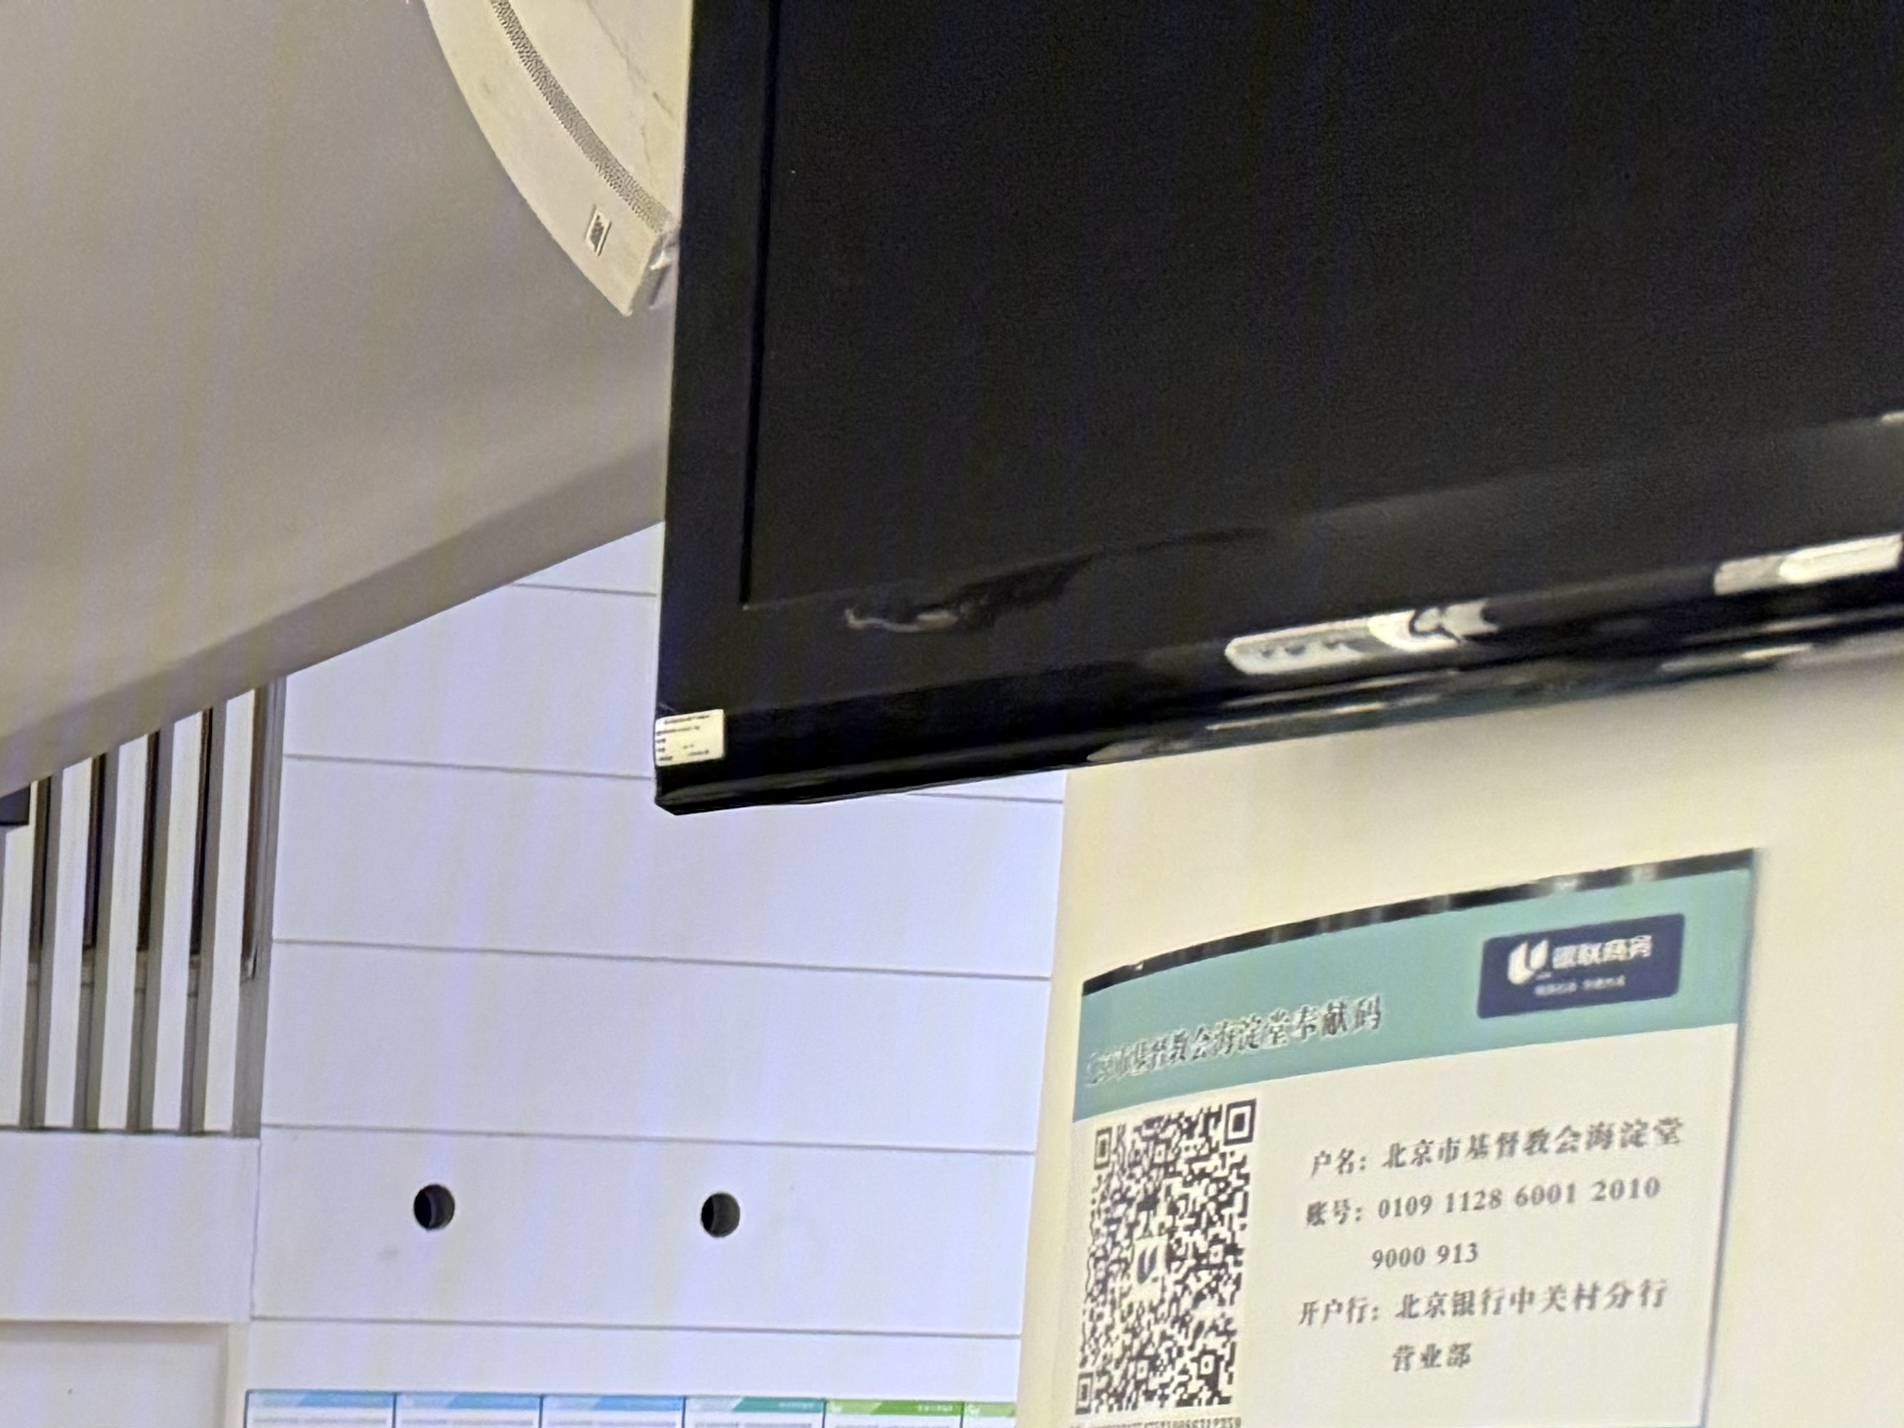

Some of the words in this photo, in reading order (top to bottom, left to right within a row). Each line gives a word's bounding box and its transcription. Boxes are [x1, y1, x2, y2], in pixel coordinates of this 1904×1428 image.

[1377, 1194, 1433, 1220] 0109
[1446, 1187, 1503, 1214] 1128
[1514, 1182, 1577, 1208] 6001
[1591, 1176, 1661, 1202] 2010
[1371, 1246, 1426, 1270] 9000
[1436, 1242, 1479, 1265] 913
[1394, 1278, 1668, 1320] 北京银行中关村分行
[1392, 1342, 1472, 1372] 营业部
